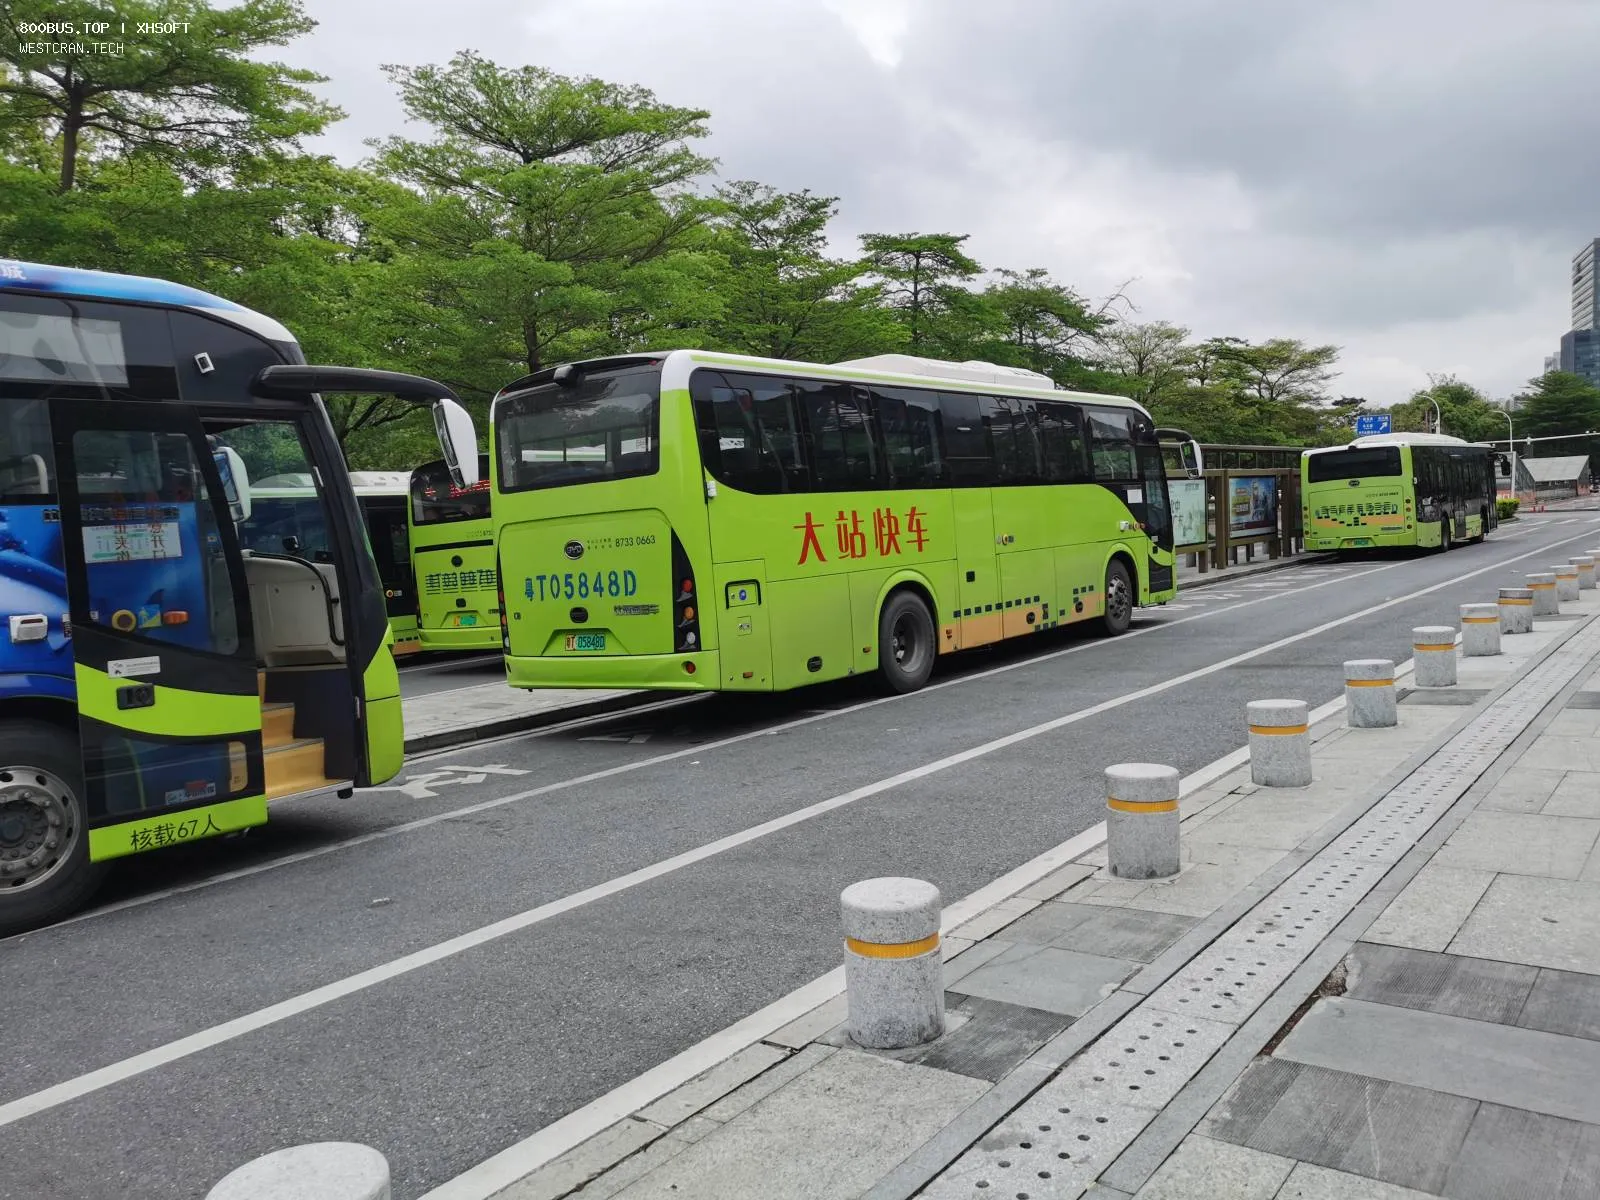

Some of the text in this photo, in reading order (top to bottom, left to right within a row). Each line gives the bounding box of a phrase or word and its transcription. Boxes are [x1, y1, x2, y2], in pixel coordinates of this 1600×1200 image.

[615, 537, 634, 548] 8733
[636, 534, 656, 546] 0663
[793, 506, 930, 566] 大站快车
[130, 813, 221, 851] 核载67人
